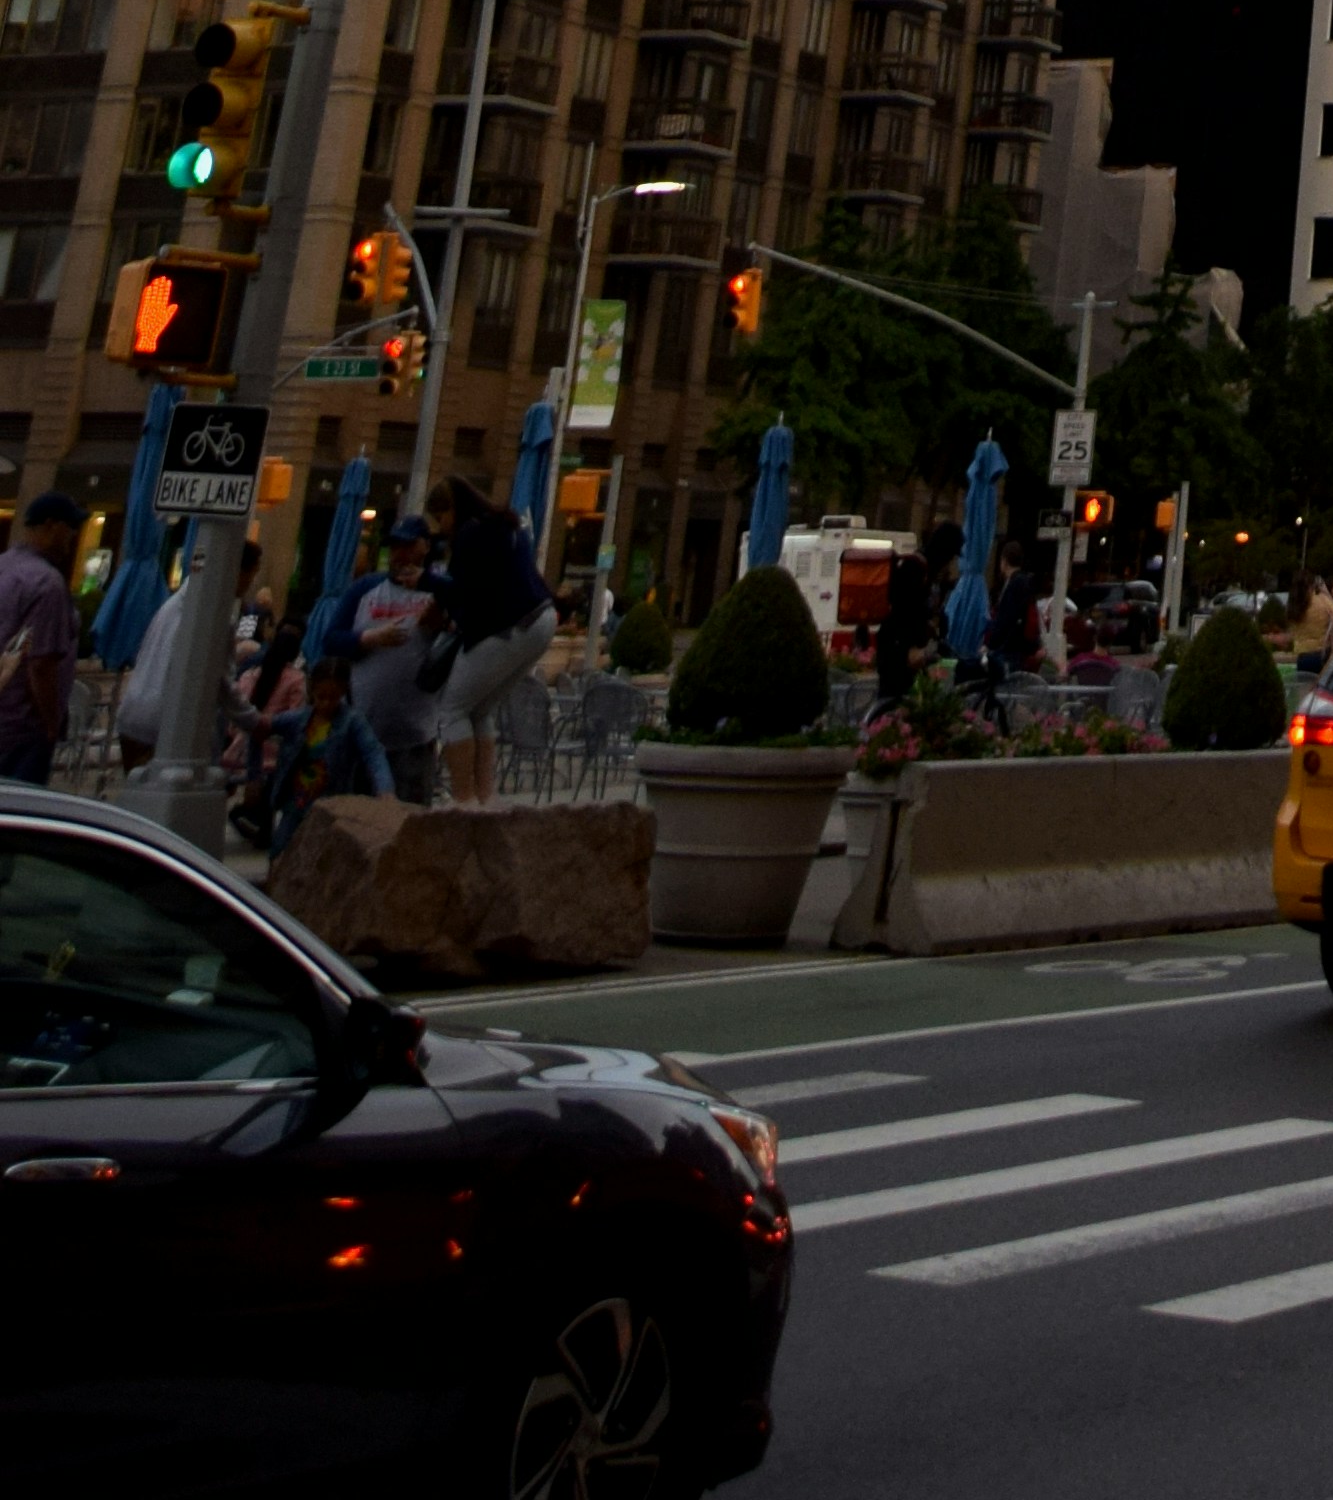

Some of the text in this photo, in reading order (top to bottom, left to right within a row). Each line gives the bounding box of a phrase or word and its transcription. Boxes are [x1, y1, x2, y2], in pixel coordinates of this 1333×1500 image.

[1058, 441, 1088, 461] 25
[161, 477, 249, 507] BIKE LANE
